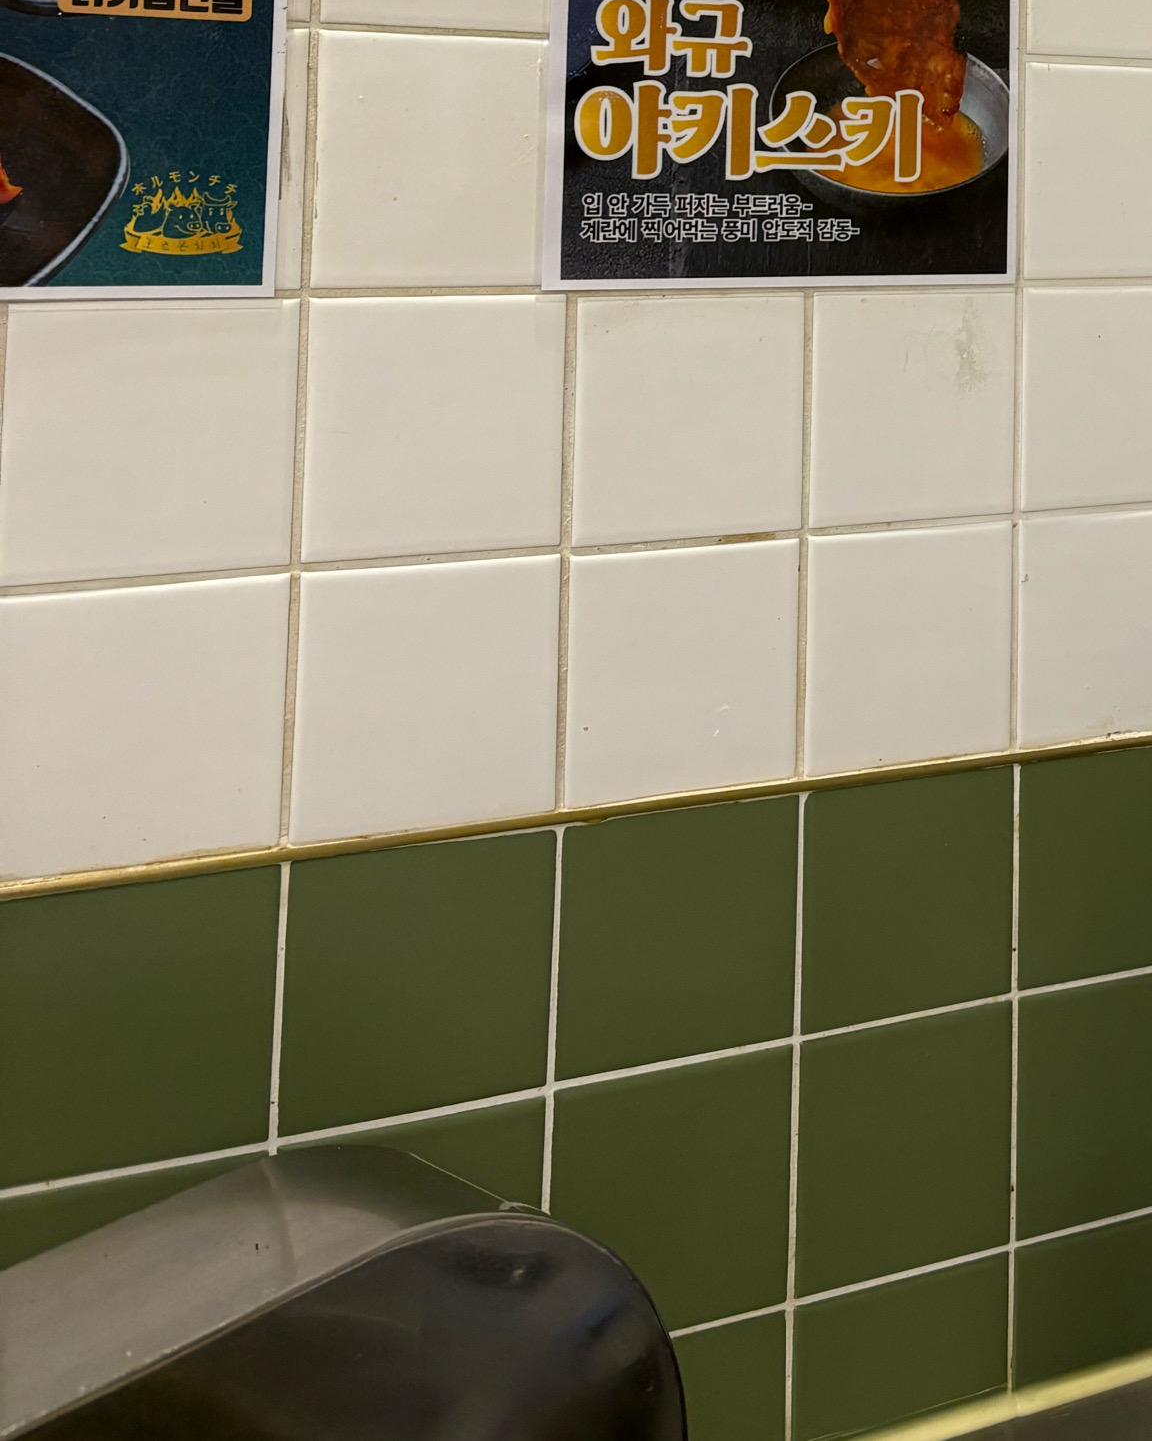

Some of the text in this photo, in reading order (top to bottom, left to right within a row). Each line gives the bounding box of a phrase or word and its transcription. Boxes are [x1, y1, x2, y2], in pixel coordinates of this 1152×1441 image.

[574, 79, 926, 183] 야키스키
[131, 170, 238, 196] ホルモンチチ
[582, 193, 602, 218] 입
[606, 193, 628, 217] 안
[631, 193, 671, 217] 가득
[675, 193, 730, 217] 퍼지는
[580, 218, 637, 244] 계란에
[720, 218, 758, 243] 풍미
[762, 218, 813, 242] 압도적
